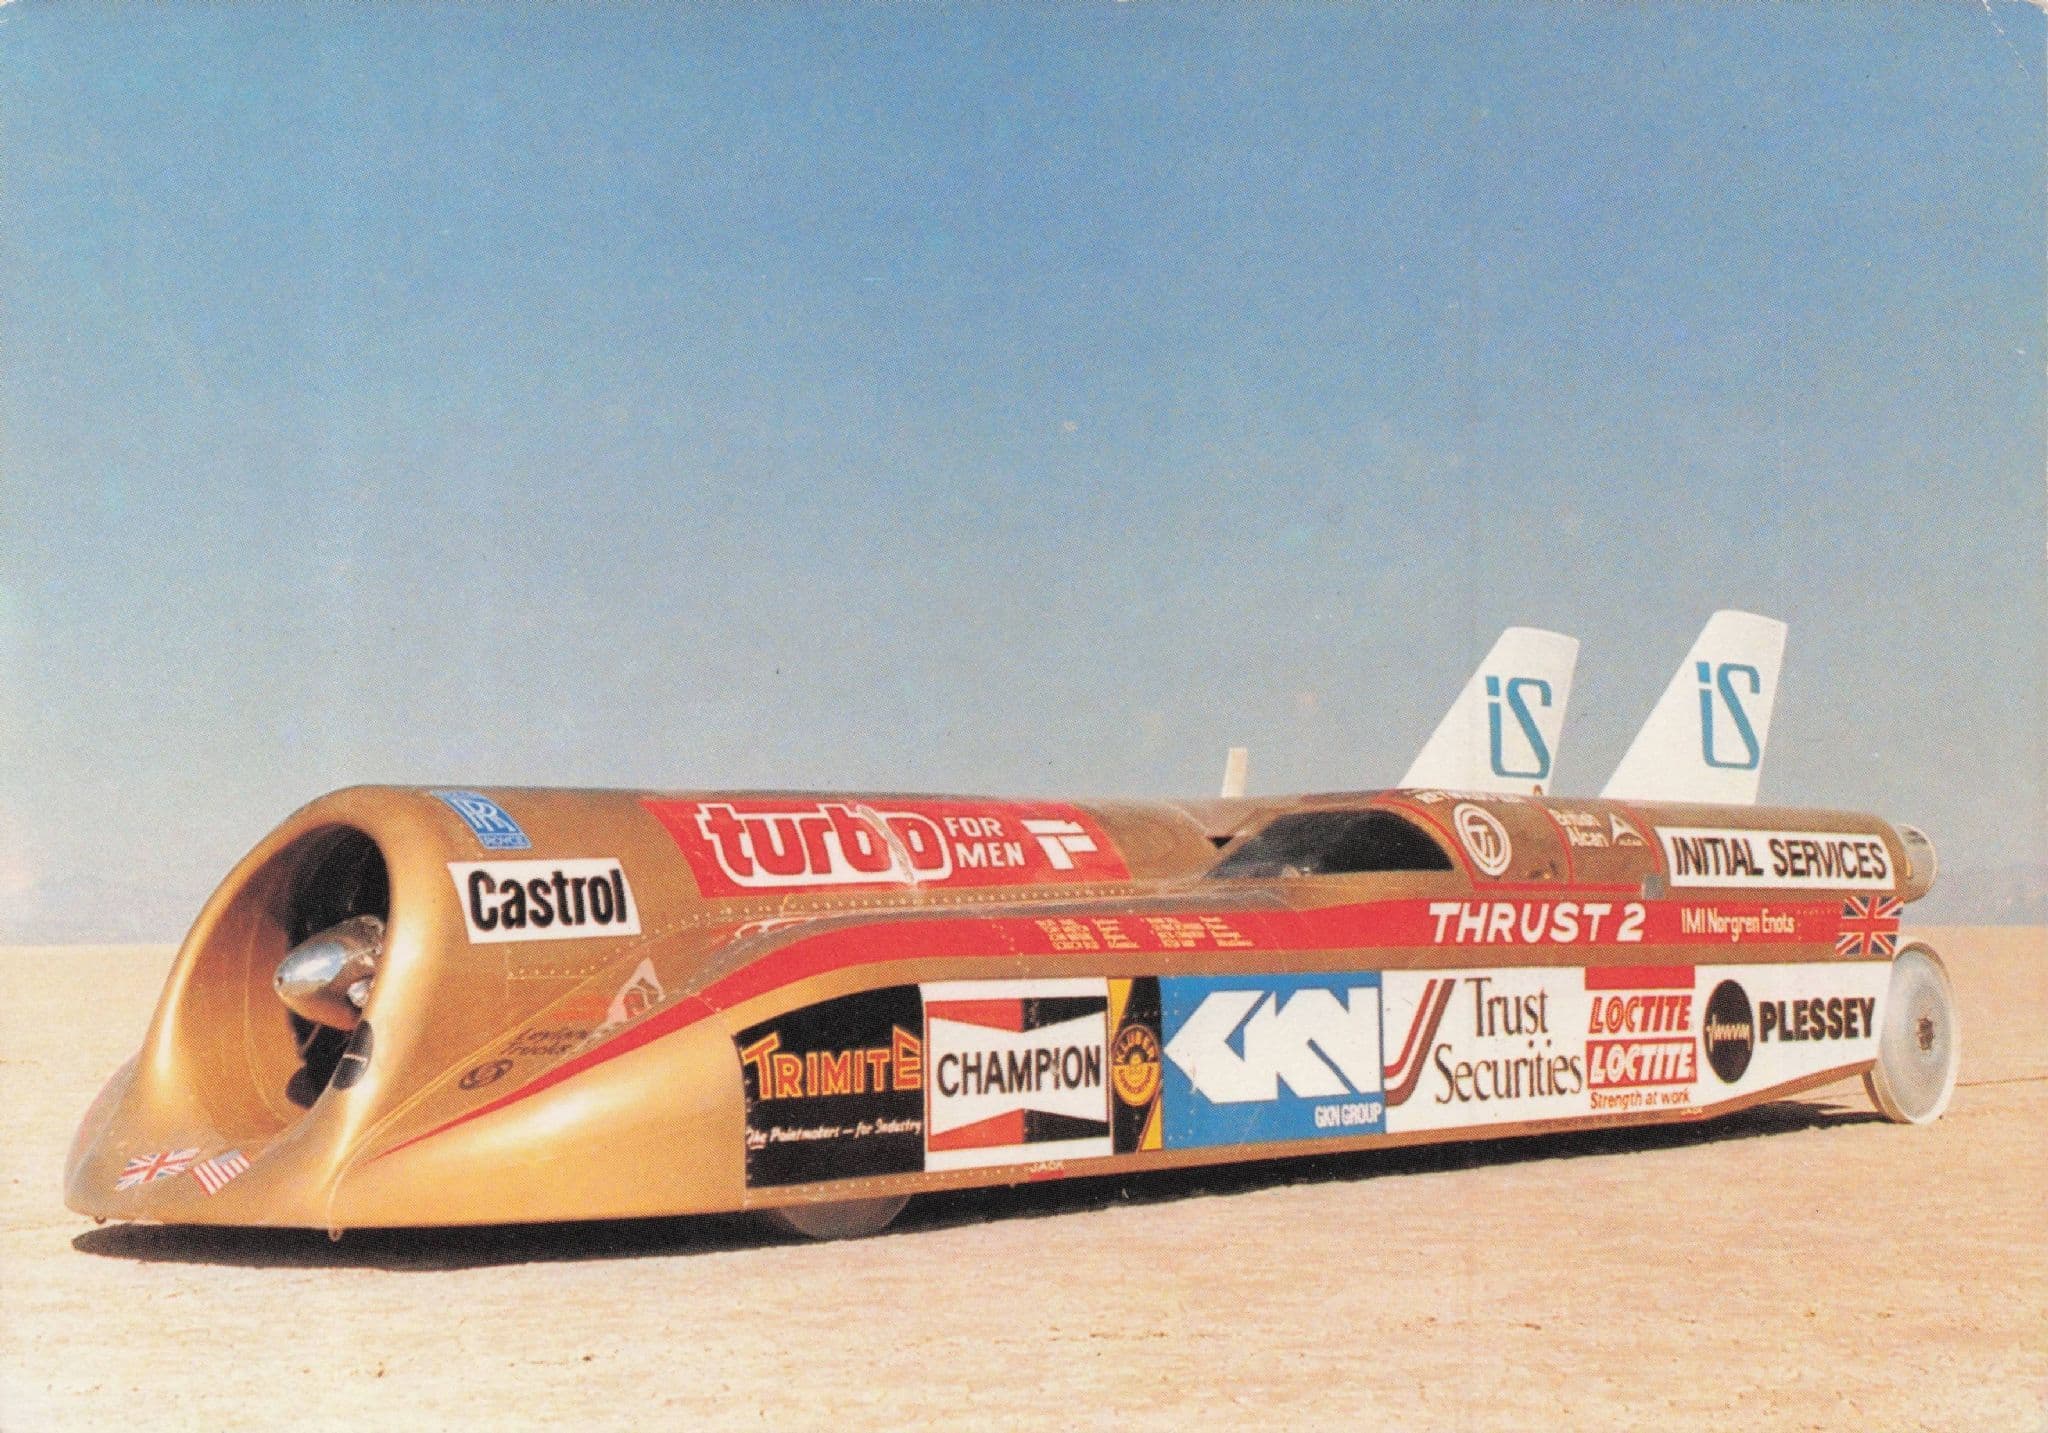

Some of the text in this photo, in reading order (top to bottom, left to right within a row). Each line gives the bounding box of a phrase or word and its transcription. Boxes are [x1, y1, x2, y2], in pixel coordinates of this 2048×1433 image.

[945, 816, 1004, 838] FOR
[956, 841, 1026, 868] MEN
[1671, 836, 1888, 880] INITIAL SERVICES
[468, 867, 627, 932] Castrol
[1429, 902, 1647, 944] THRUST 2
[1681, 907, 1706, 934] IMI
[1707, 907, 1760, 943] Norgren
[1465, 977, 1549, 1037] Trust
[1588, 995, 1692, 1034] LOCTITE
[1760, 996, 1876, 1042] PLESSEY
[741, 1025, 922, 1101] TRIMITE
[936, 1045, 1101, 1098] CHAMPION
[1434, 1039, 1583, 1104] Securities
[1589, 1042, 1693, 1084] LOCTITE
[1315, 1101, 1383, 1128] GKN GROUP
[1590, 1088, 1690, 1110] Strength at work
